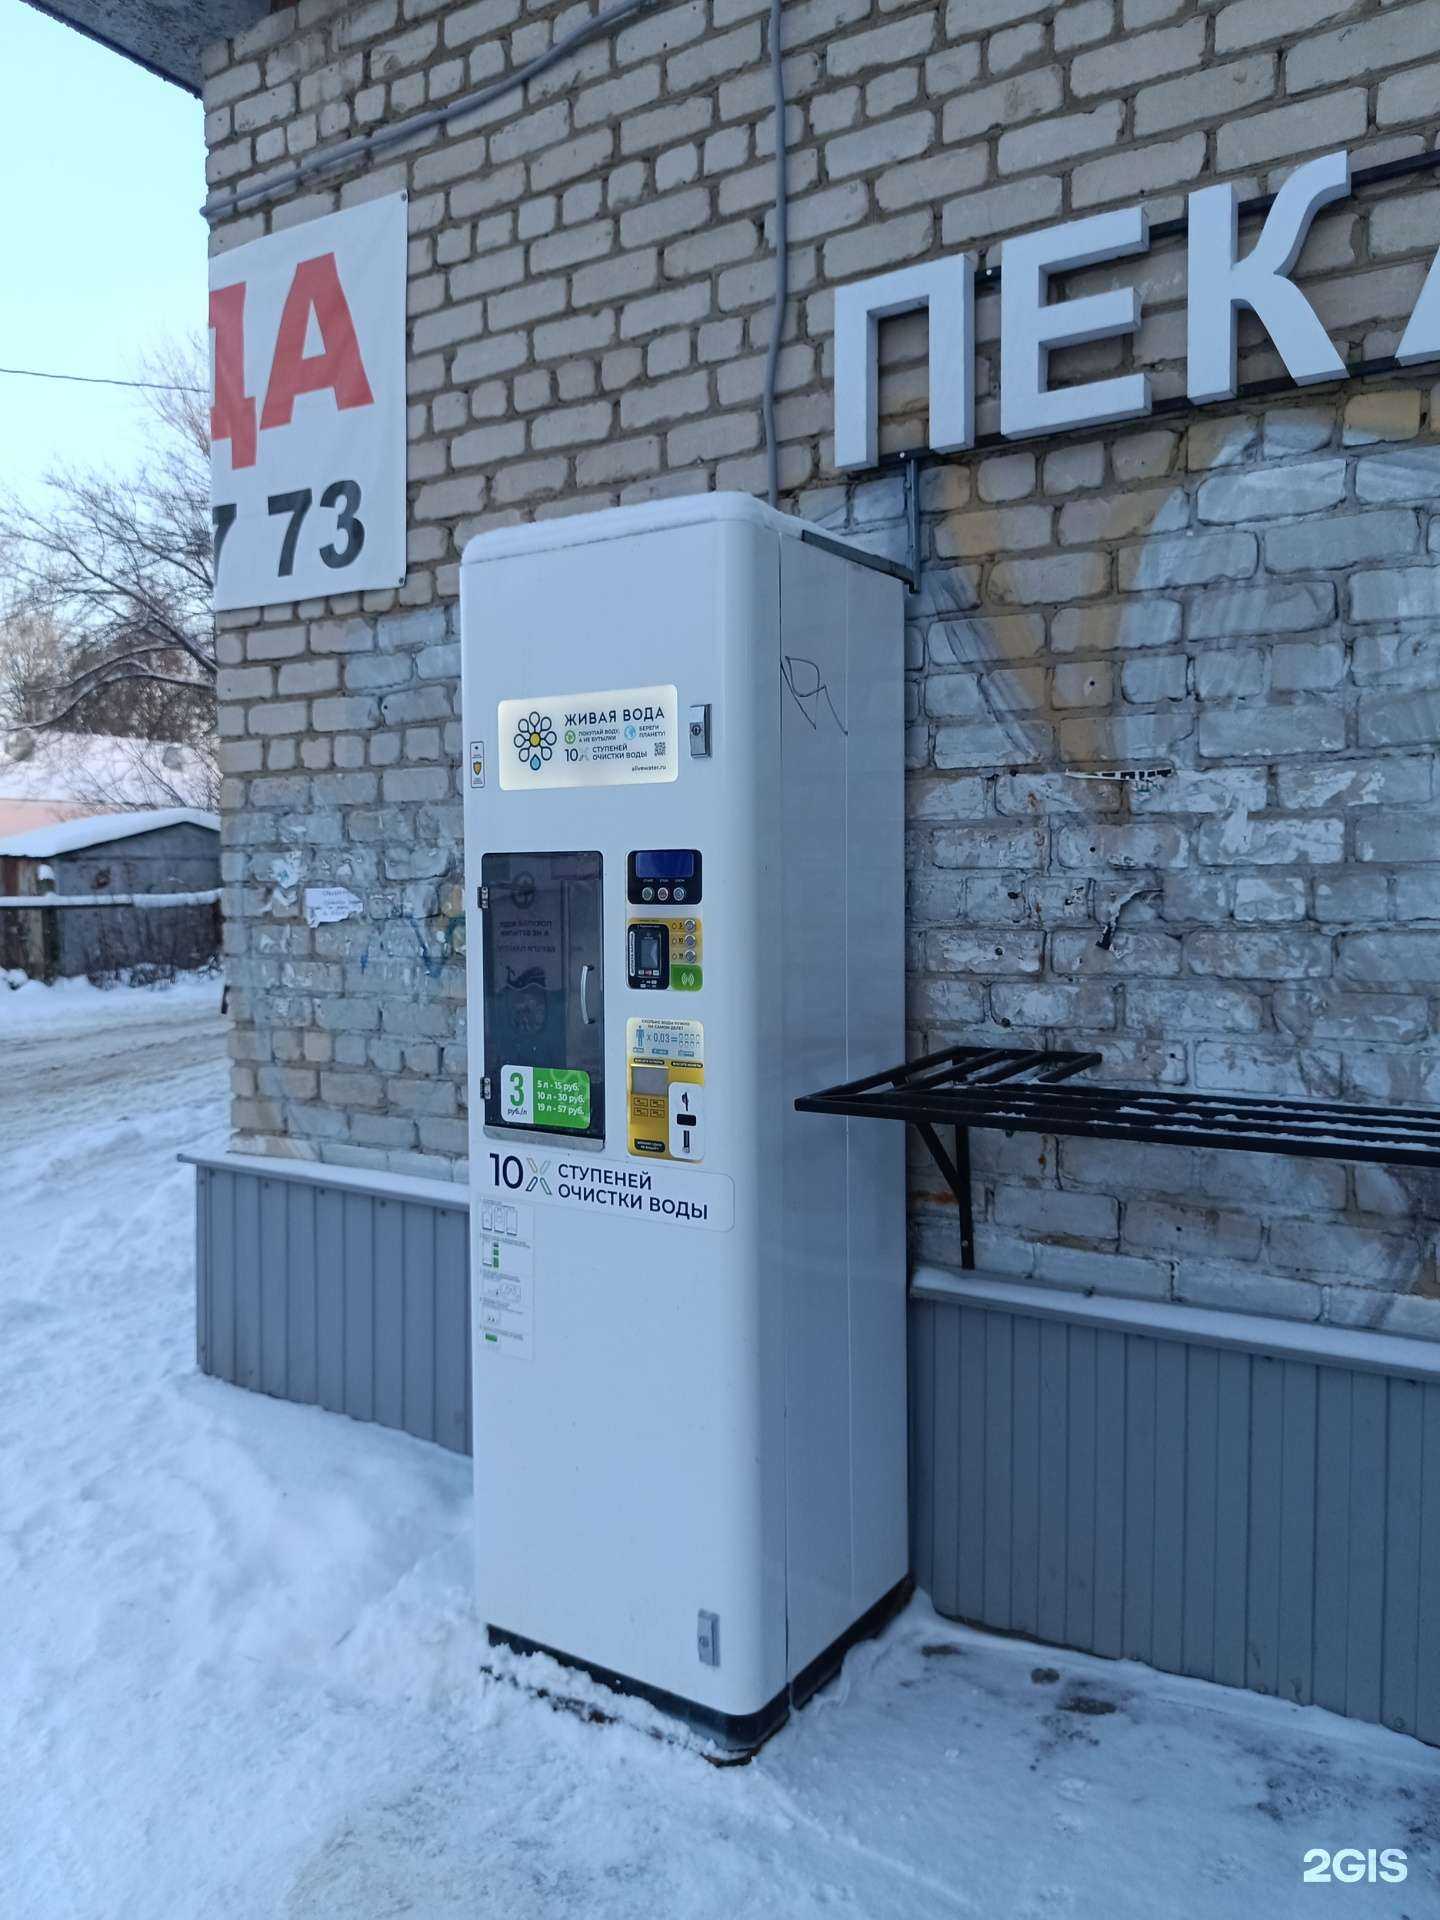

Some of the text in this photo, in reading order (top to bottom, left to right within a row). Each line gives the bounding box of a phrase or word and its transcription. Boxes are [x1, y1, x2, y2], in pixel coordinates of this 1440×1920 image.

[564, 706, 665, 727] ЖИВАЯ ВОДА
[592, 744, 628, 753] СТУПЕНЕЙ
[592, 751, 648, 761] ОЧИСТКИ ВОДЫ
[509, 1072, 525, 1106] 3
[537, 1080, 542, 1088] 5
[555, 1081, 562, 1090] 15
[563, 1083, 580, 1093] руб.
[537, 1091, 545, 1100] 10
[558, 1093, 567, 1101] 30
[569, 1094, 585, 1104] руб.
[537, 1102, 545, 1111] 19
[558, 1104, 567, 1113] 57
[568, 1106, 585, 1116] руб.
[558, 1163, 652, 1190] СТУПЕНЕЙ
[558, 1183, 708, 1220] ОЧИСТКИ ВОДЫ
